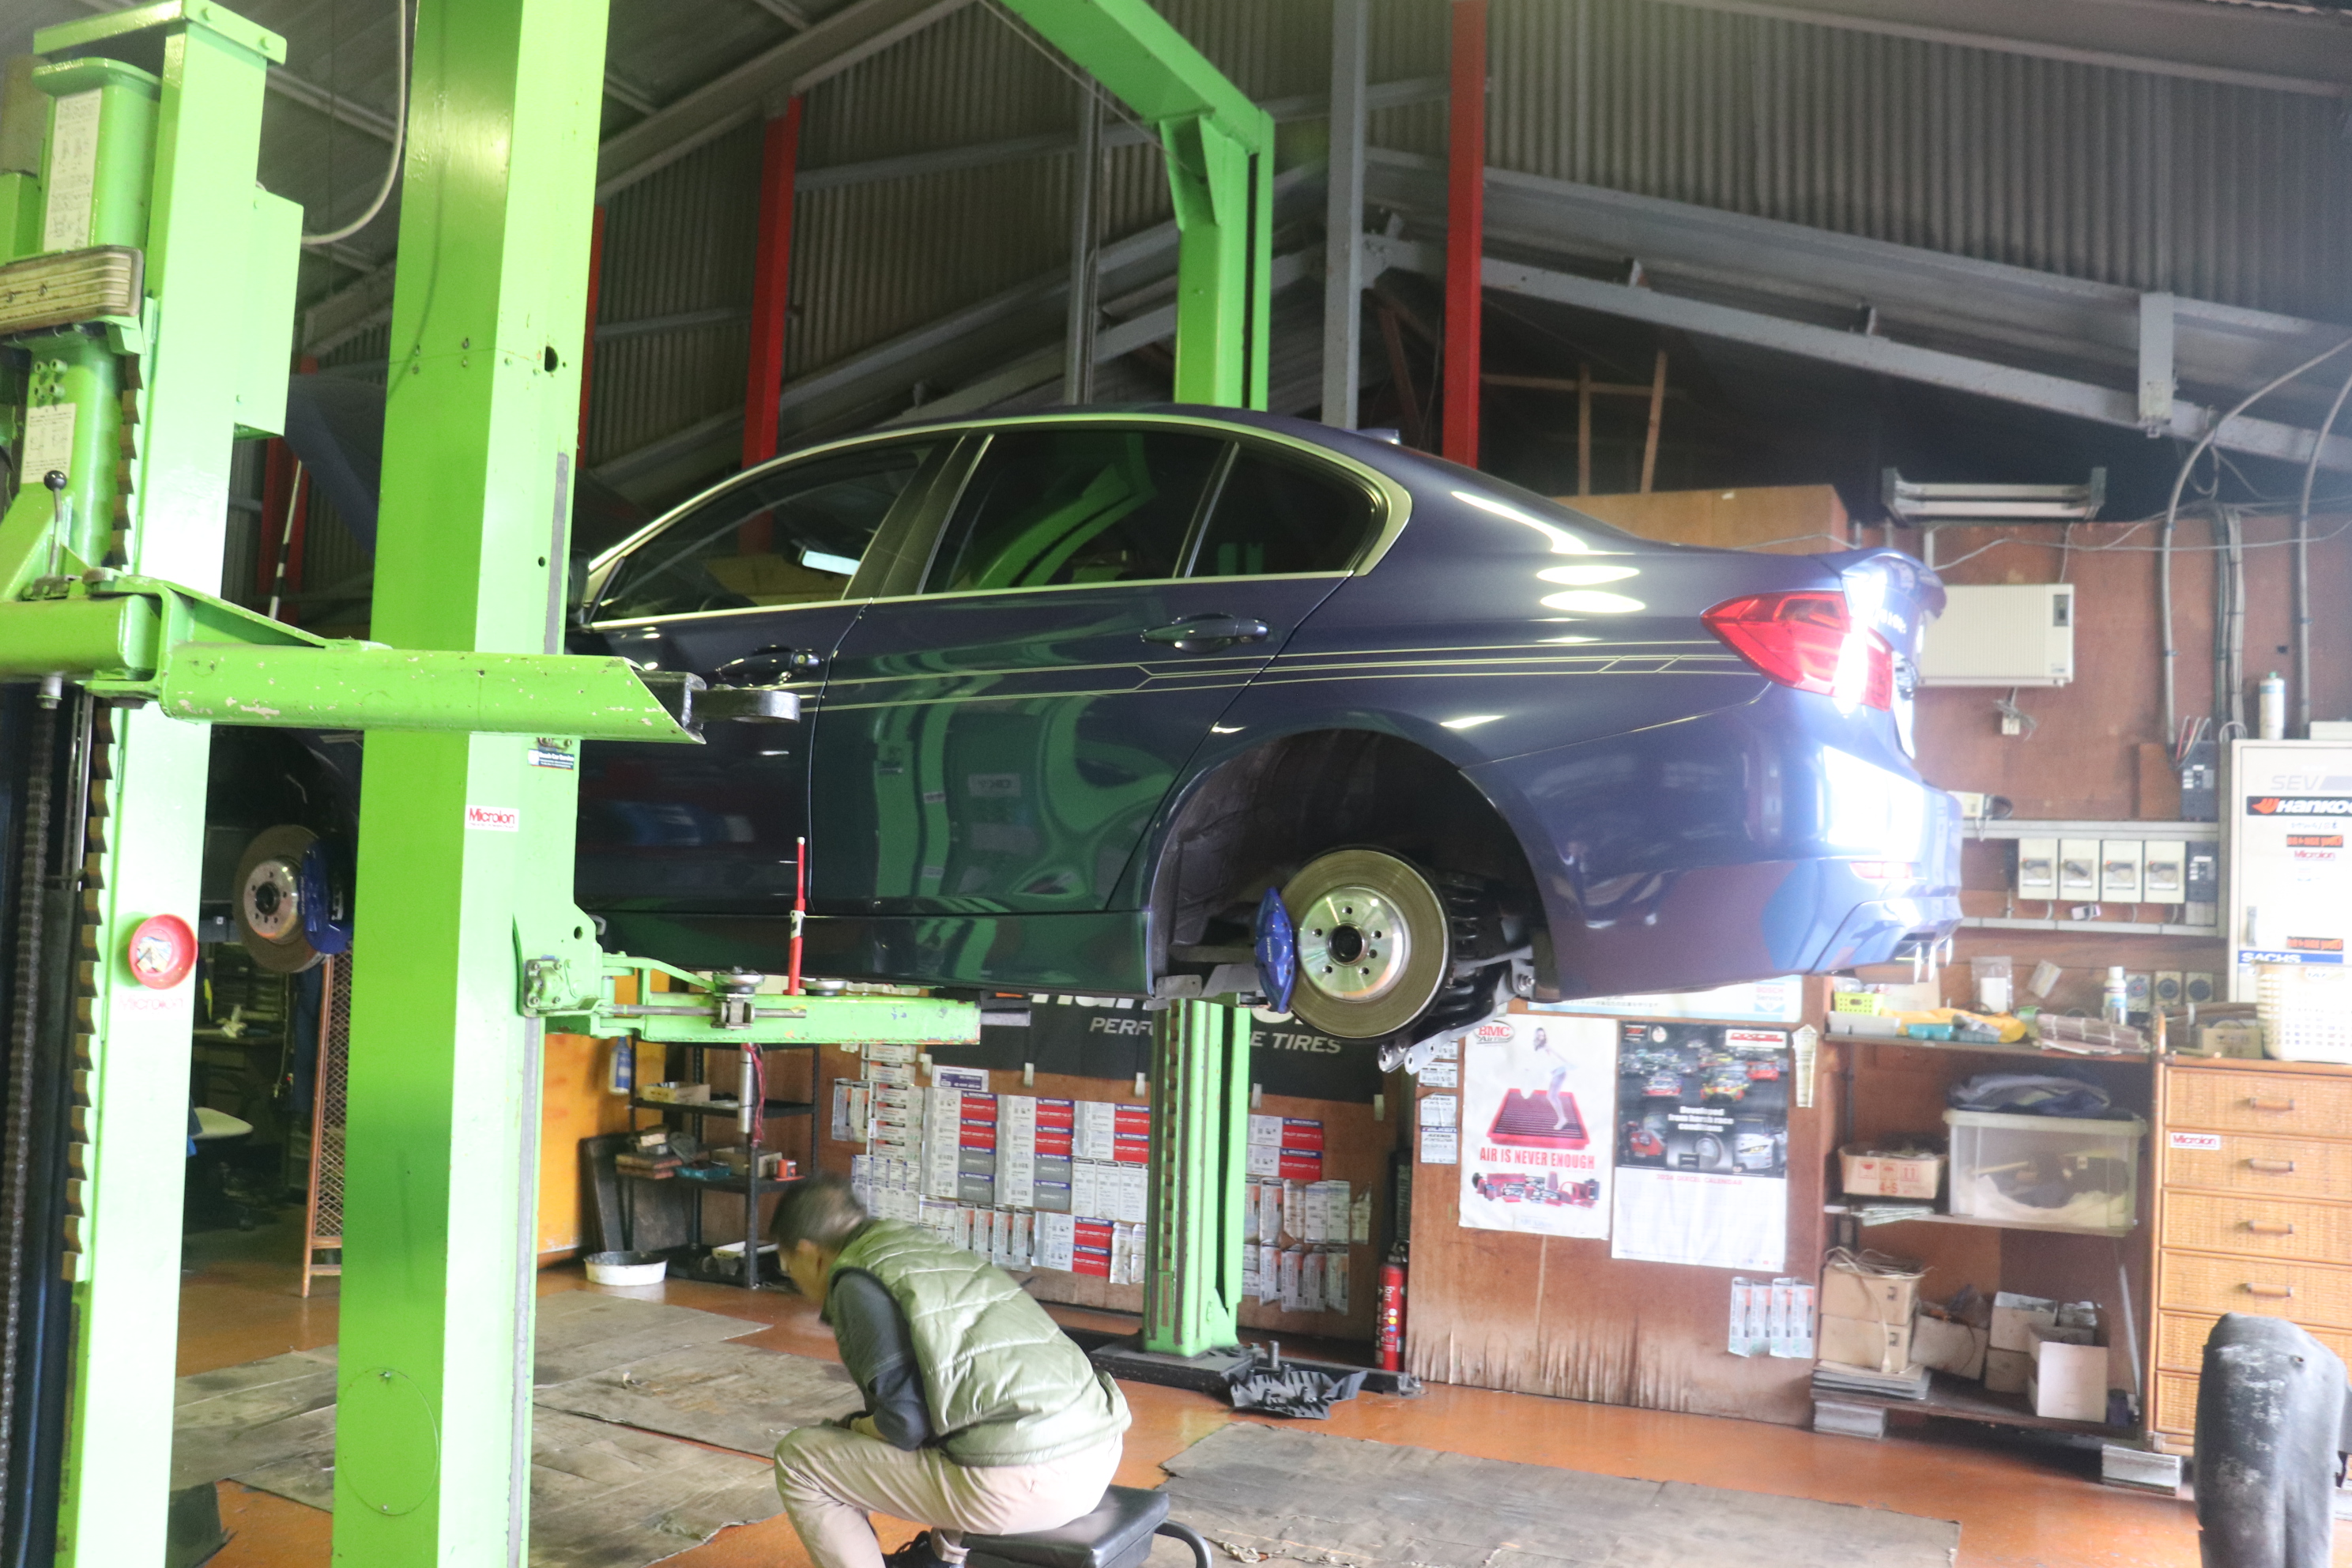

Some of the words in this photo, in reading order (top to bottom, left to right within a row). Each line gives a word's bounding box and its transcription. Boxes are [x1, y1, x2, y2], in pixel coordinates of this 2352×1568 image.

[2271, 775, 2319, 790] SEV
[2241, 952, 2301, 963] SACHS
[1479, 1026, 1511, 1037] BMC
[1272, 1032, 1341, 1054] TIRES
[1479, 1147, 1498, 1162] AIR
[1501, 1148, 1511, 1163] IS
[1514, 1150, 1547, 1166] NEVER
[1551, 1152, 1595, 1170] ENOUGH
[1705, 1177, 1743, 1185] CALENDAR
